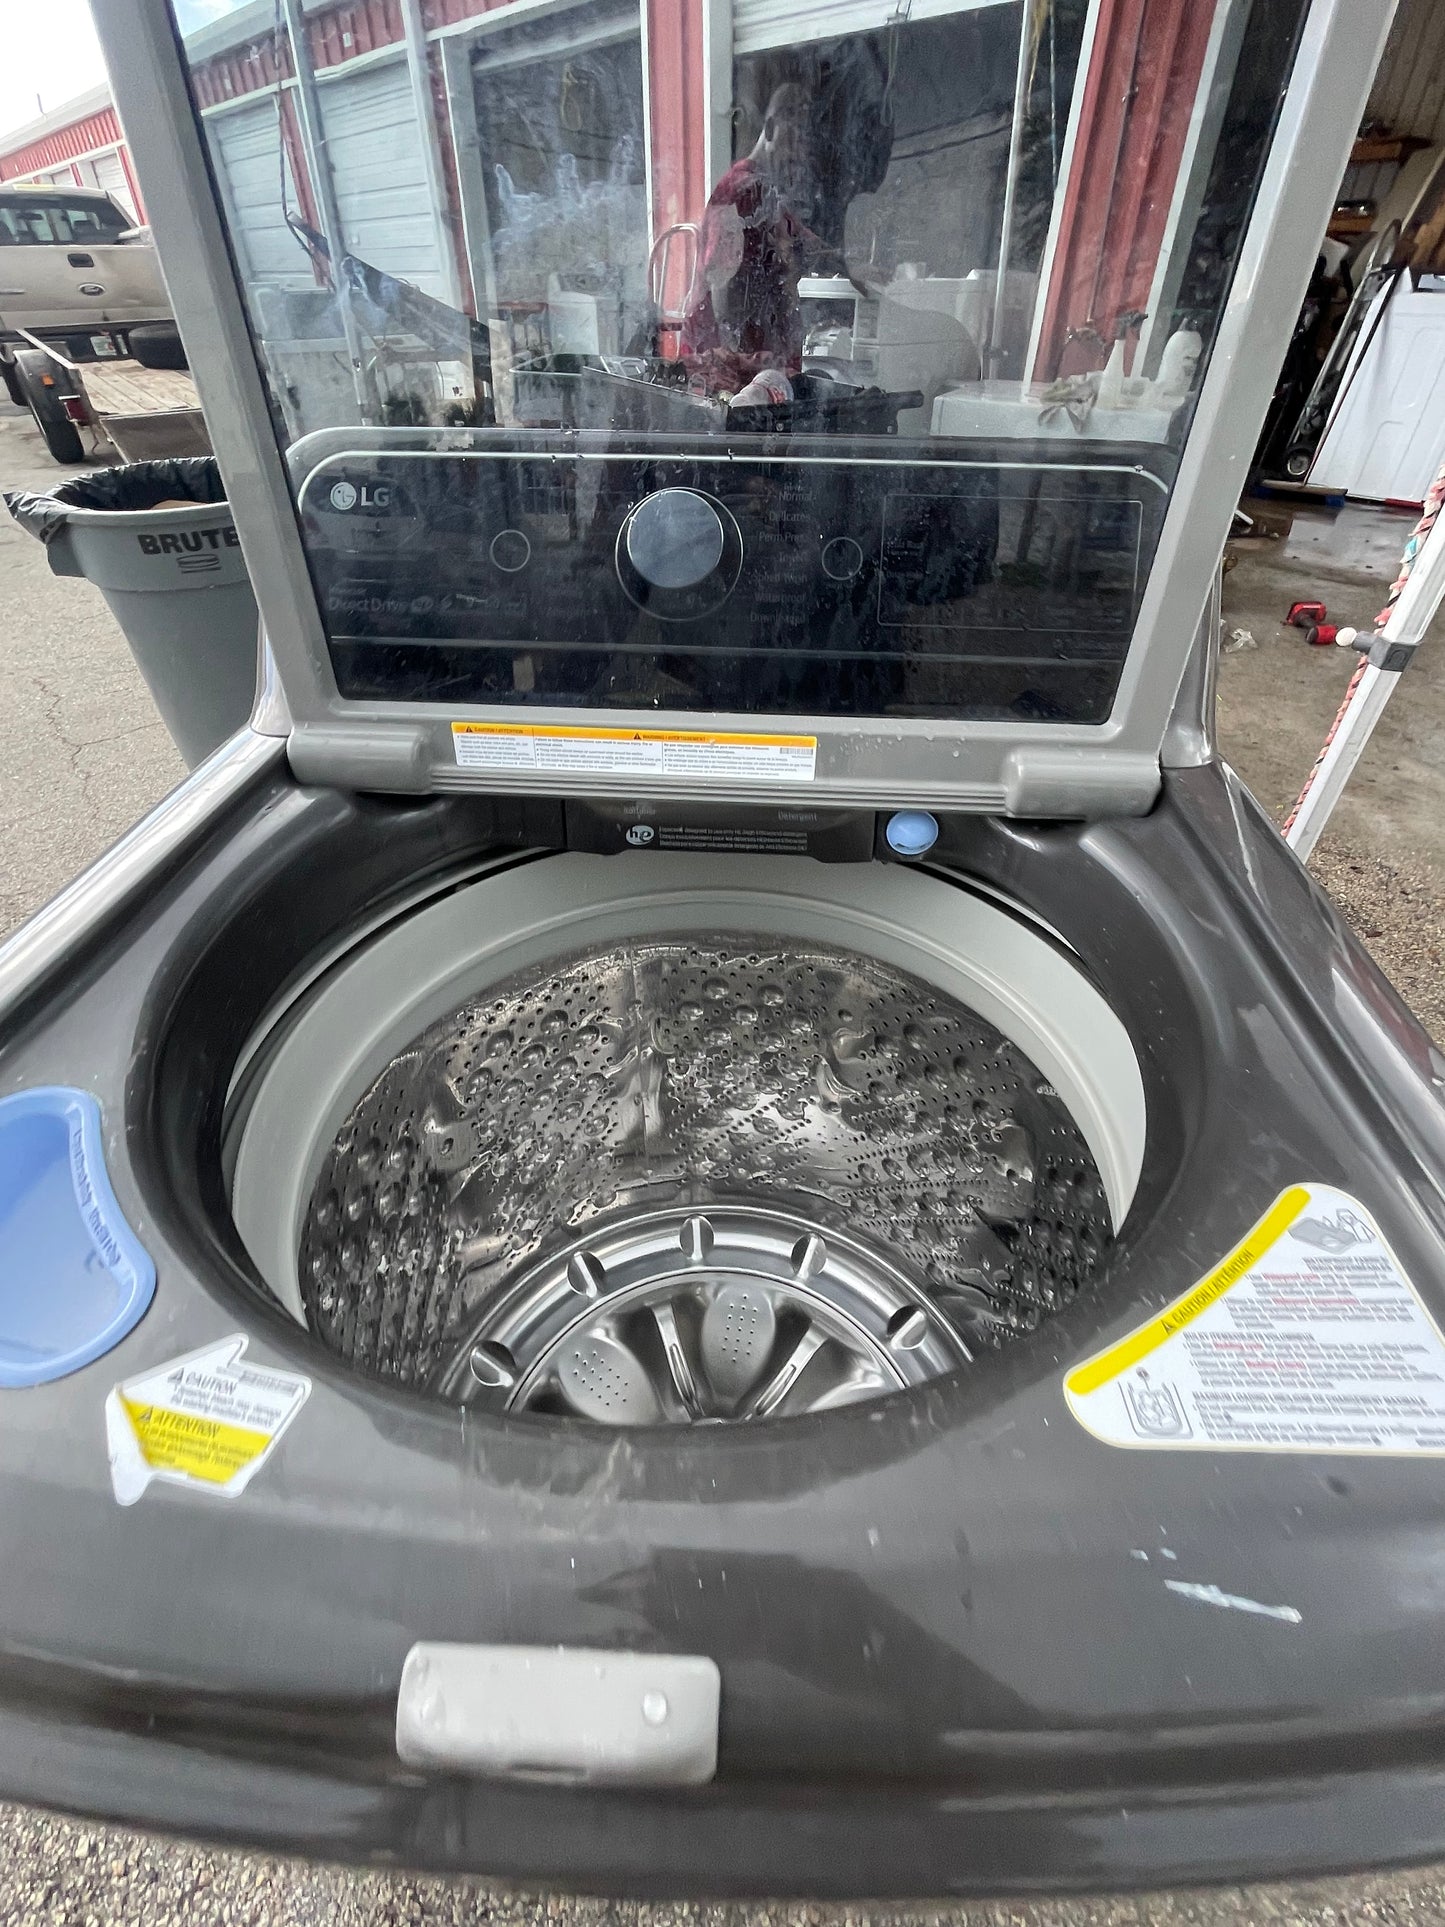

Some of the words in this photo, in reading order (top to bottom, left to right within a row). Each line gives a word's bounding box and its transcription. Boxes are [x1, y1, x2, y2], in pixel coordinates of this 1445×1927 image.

[360, 486, 390, 507] LG
[138, 526, 241, 554] BRUTE
[1171, 1288, 1213, 1324] CAUTION
